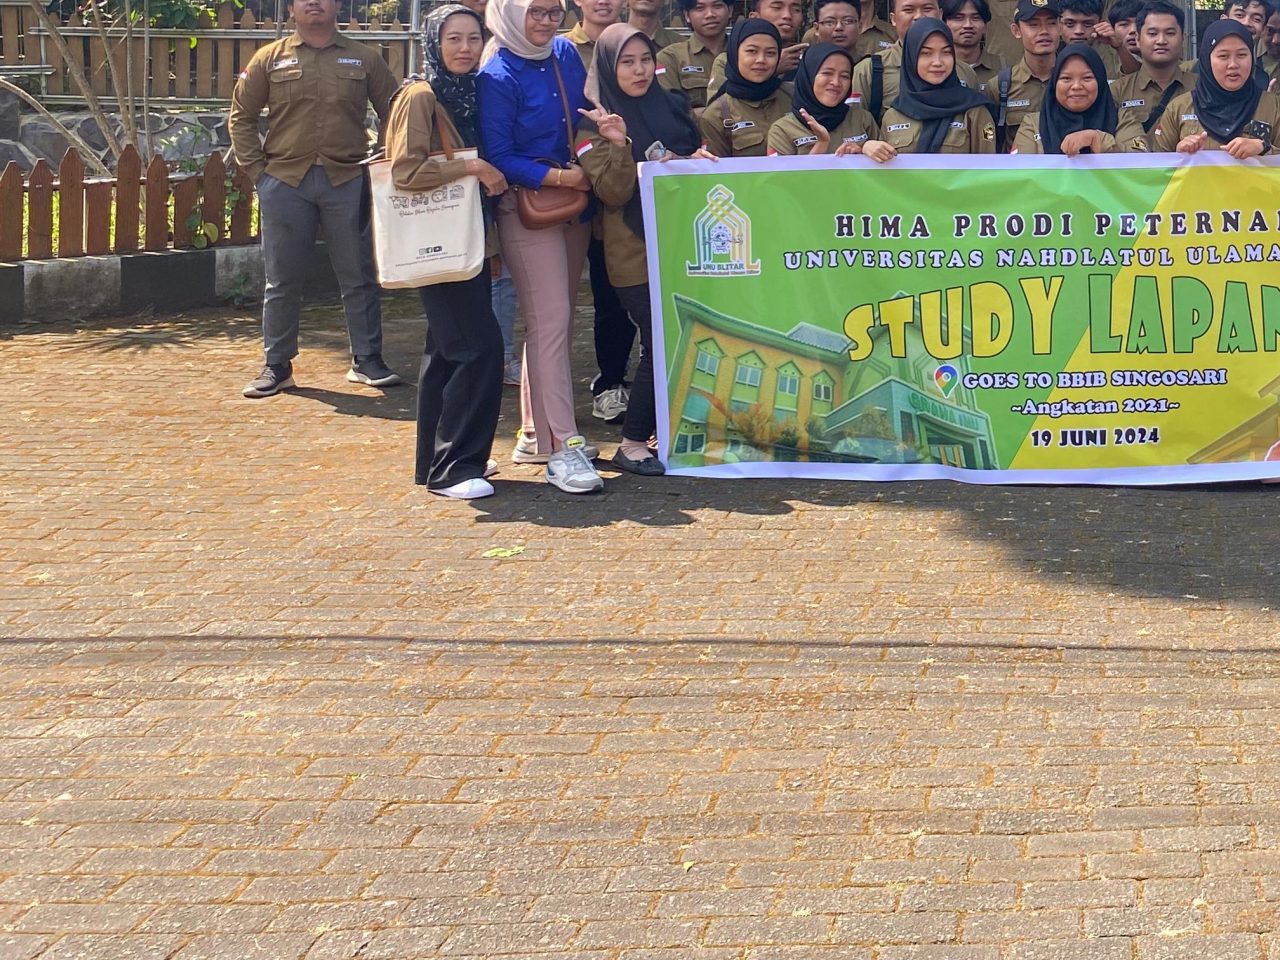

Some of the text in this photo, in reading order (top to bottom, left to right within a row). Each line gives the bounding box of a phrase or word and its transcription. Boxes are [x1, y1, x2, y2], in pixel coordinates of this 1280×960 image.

[834, 213, 930, 238] HIMA
[953, 213, 1073, 238] PRODI
[702, 263, 745, 271] UNU BLITAR
[783, 248, 984, 270] UNIVERSITAS
[996, 246, 1174, 268] NAHDLATUL
[842, 275, 1065, 362] STUDY
[962, 368, 1228, 389] GOES TO BBIB SINGOSARI
[1031, 427, 1160, 447] 19 JUNI 2024
